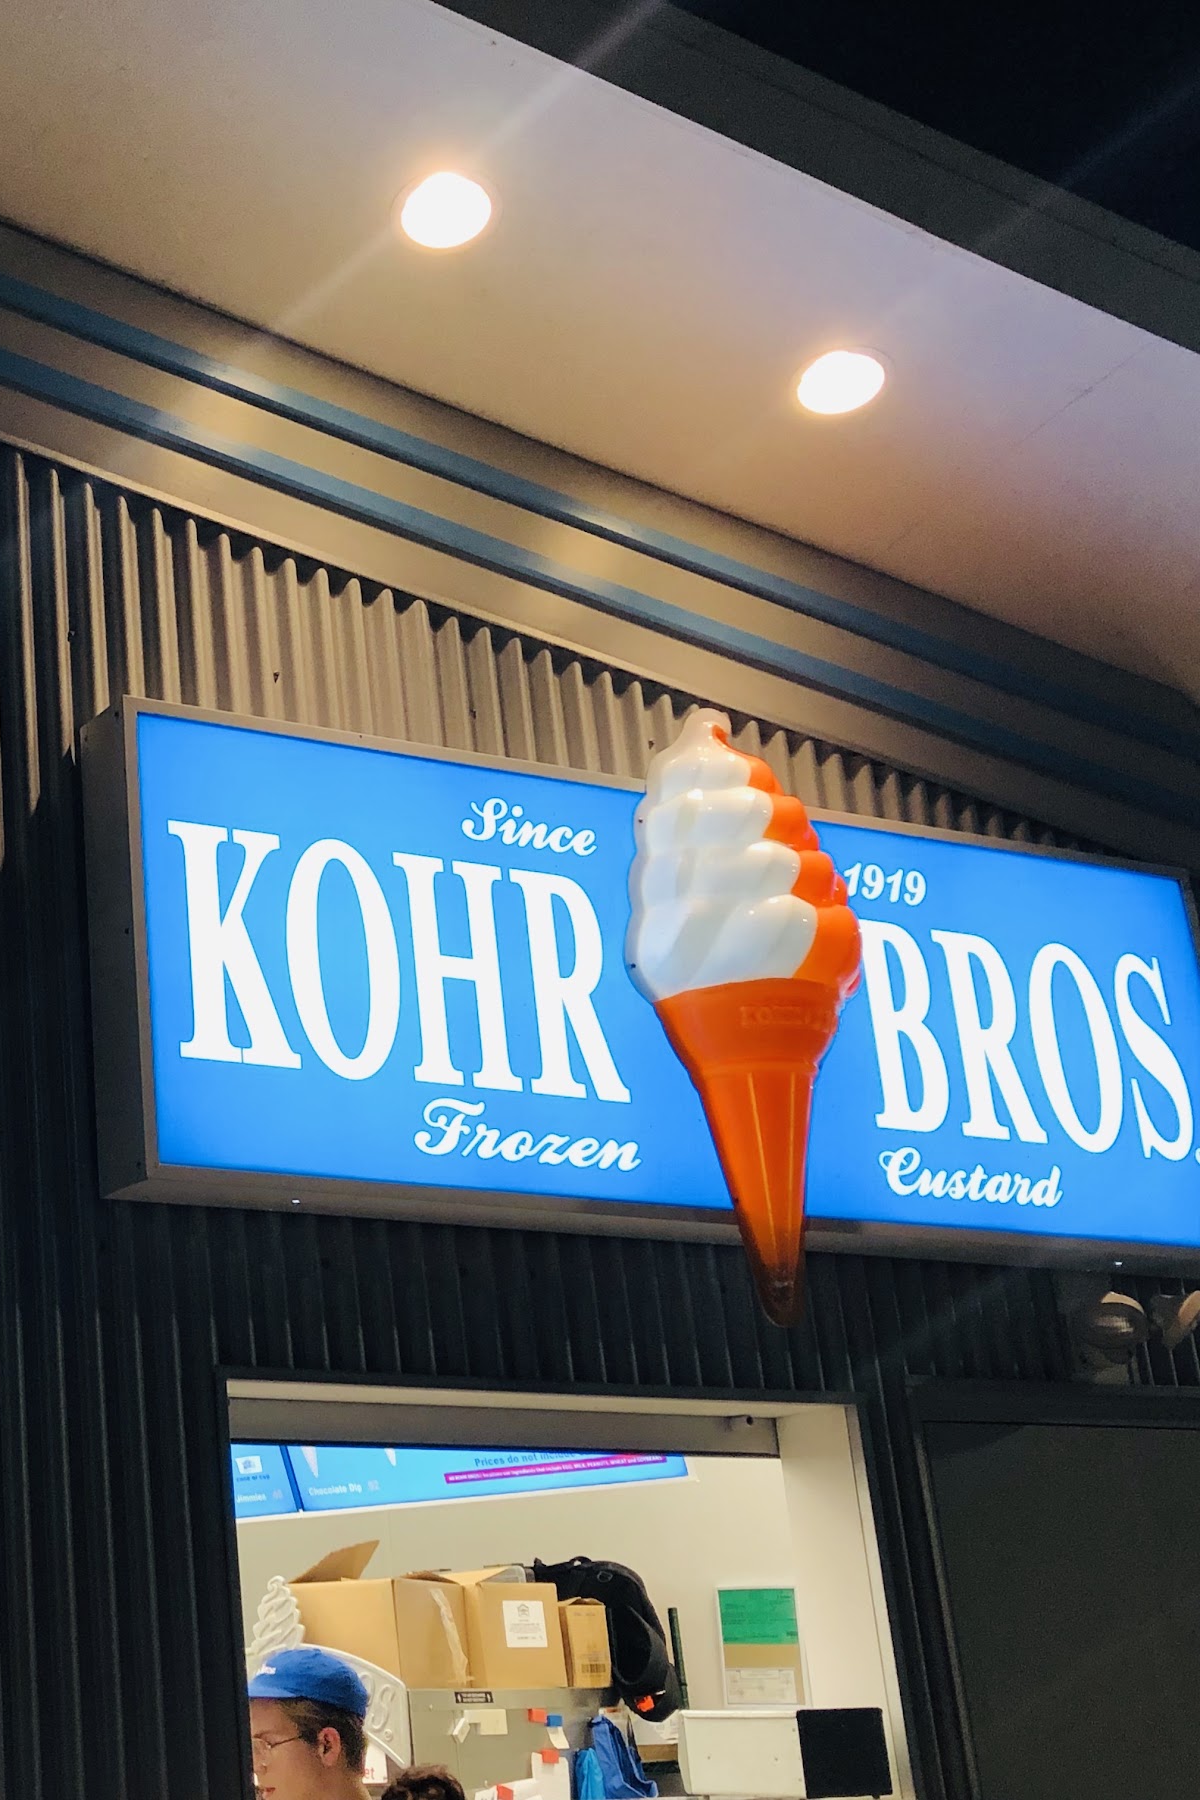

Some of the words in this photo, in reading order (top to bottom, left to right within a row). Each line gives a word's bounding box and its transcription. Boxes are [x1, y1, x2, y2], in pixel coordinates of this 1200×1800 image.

[461, 797, 598, 857] Since
[843, 862, 927, 907] 1919
[167, 820, 632, 1104] KOHR
[856, 918, 1194, 1162] BROS
[413, 1097, 641, 1172] Frozen
[878, 1146, 1064, 1208] Custard
[308, 1484, 347, 1496] Chocolate
[349, 1483, 362, 1494] Dip
[474, 1457, 505, 1467] Prices
[507, 1454, 519, 1464] do
[522, 1452, 538, 1462] not
